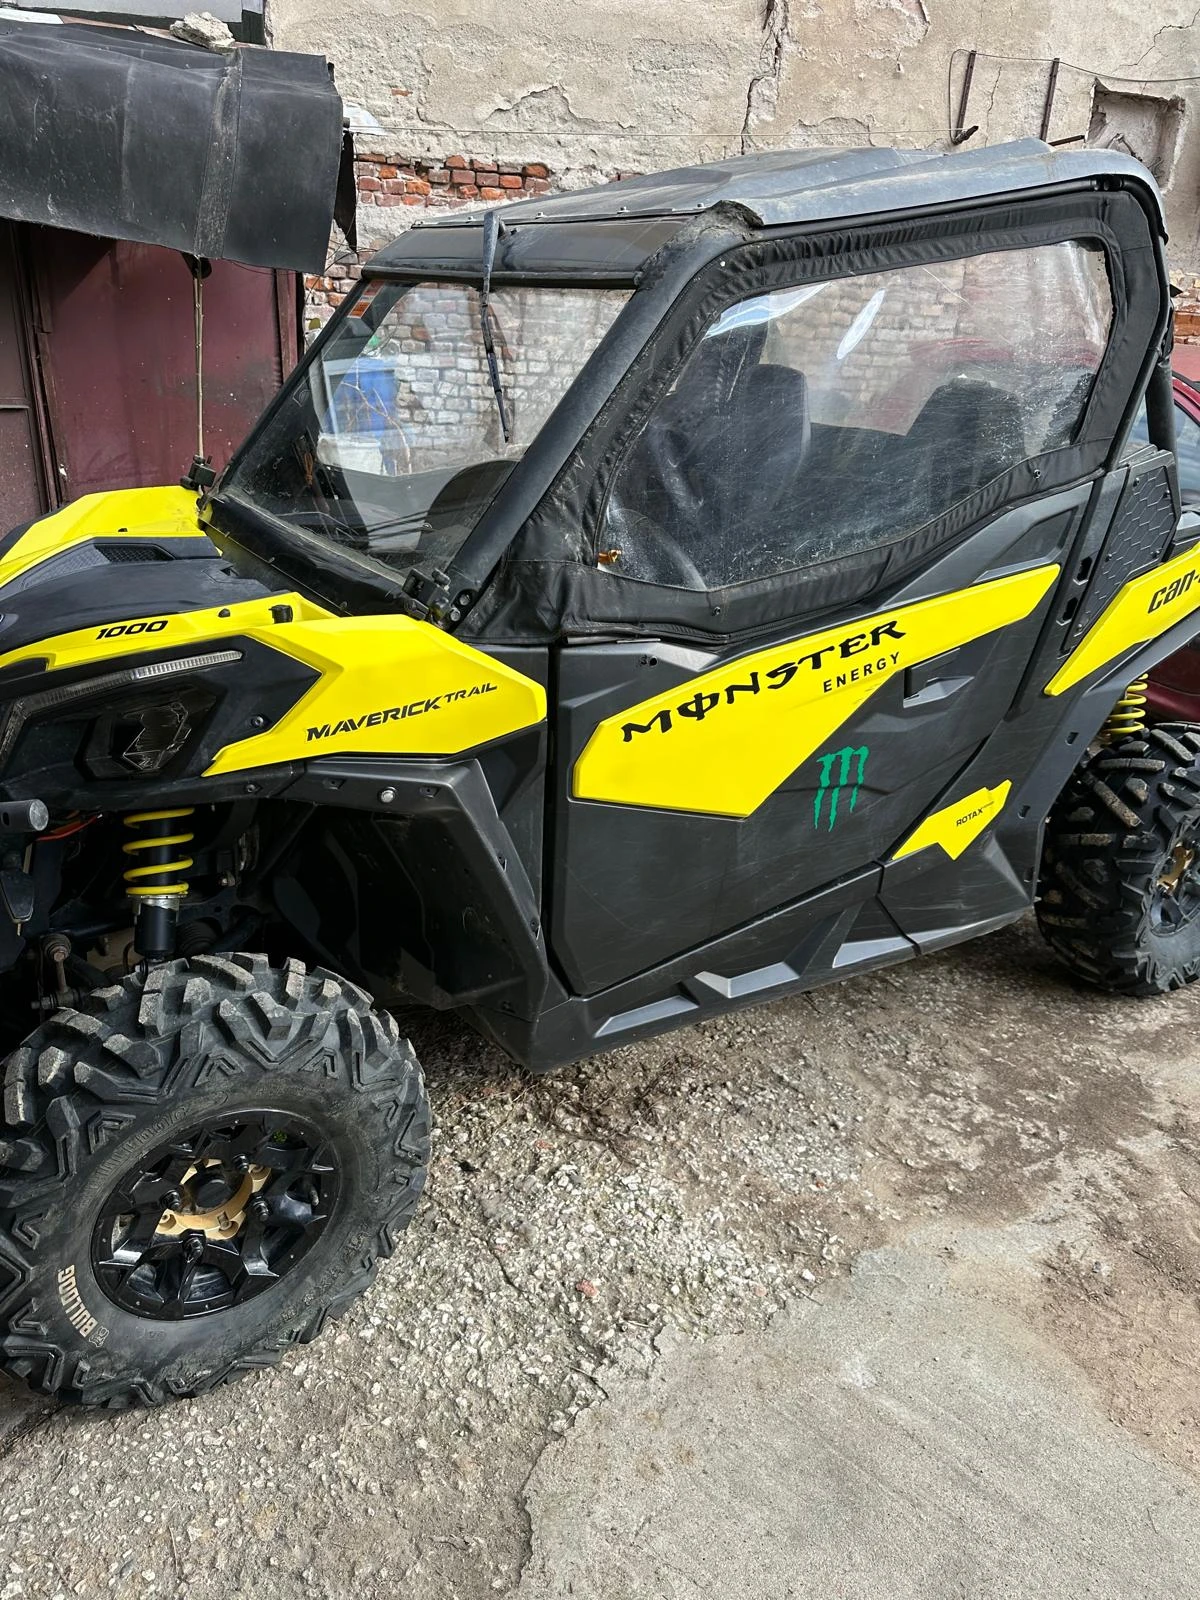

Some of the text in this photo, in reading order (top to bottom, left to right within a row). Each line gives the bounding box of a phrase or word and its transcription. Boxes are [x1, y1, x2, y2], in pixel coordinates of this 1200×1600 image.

[95, 619, 169, 641] 1000
[822, 651, 901, 694] ENERGY
[305, 683, 498, 742] MAVERICK TRAIL
[955, 807, 984, 827] ROTAX
[57, 1264, 99, 1338] BULLDOG
